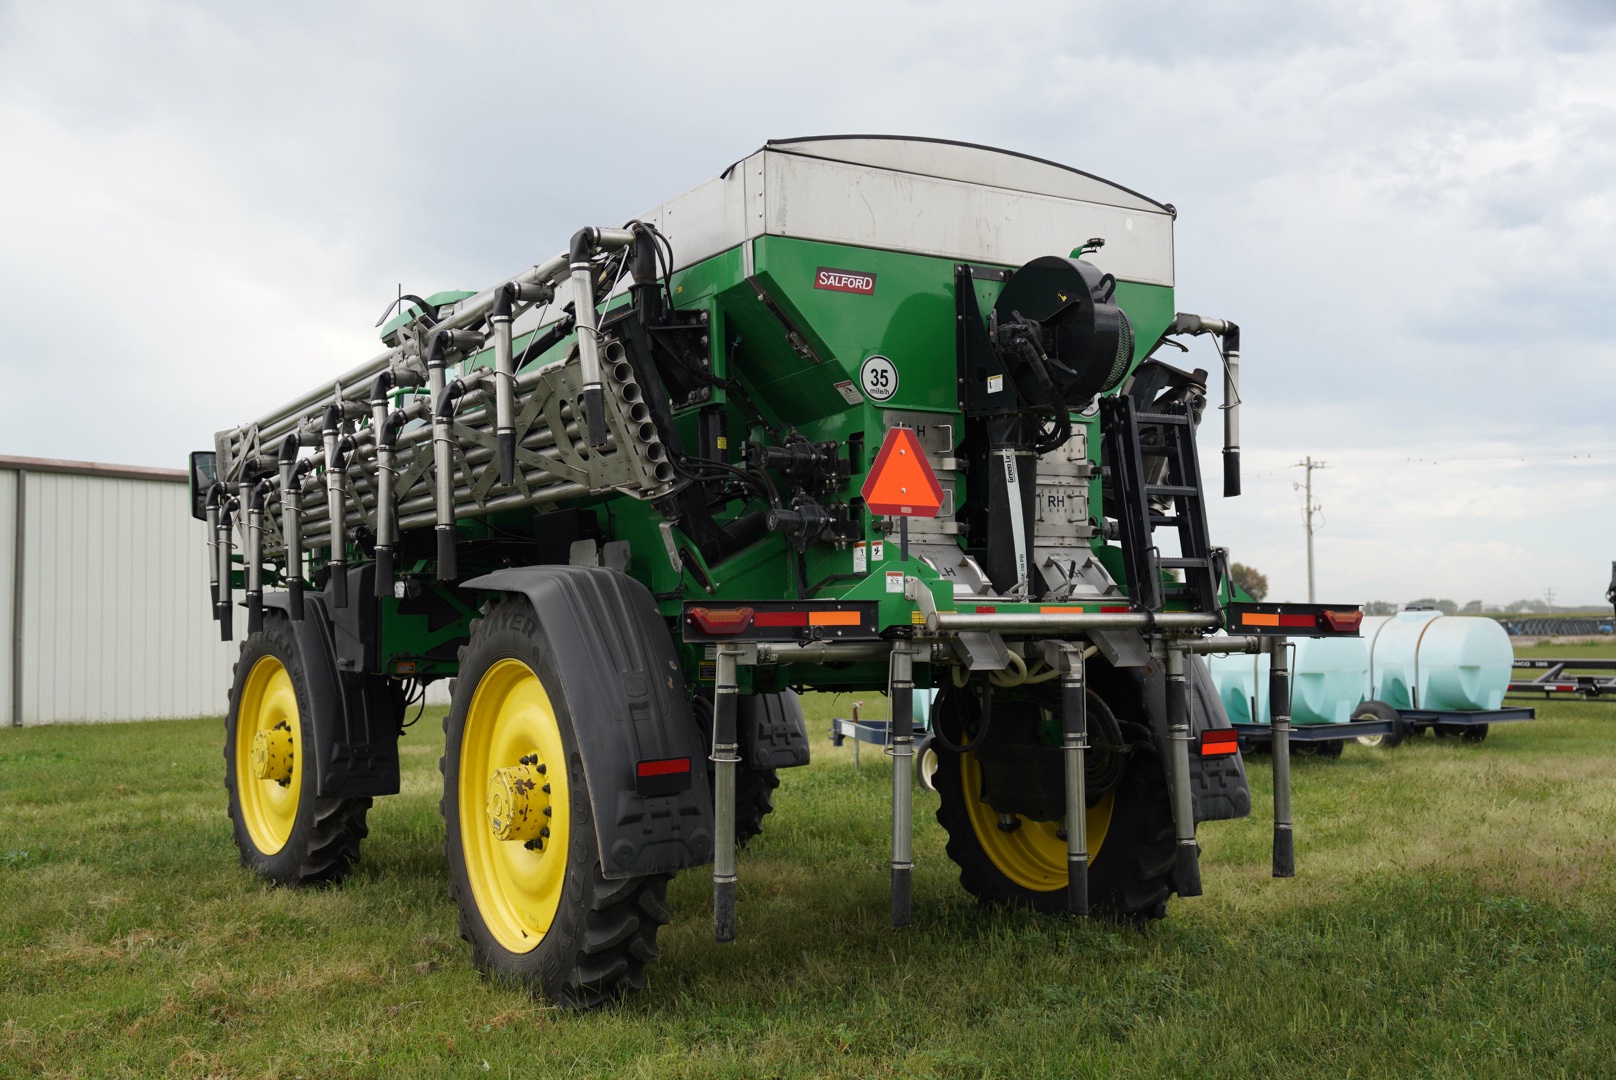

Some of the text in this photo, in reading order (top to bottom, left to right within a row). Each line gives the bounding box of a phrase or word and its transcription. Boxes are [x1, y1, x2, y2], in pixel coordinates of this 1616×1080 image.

[819, 271, 873, 290] SALFORD
[870, 368, 889, 388] 35
[869, 387, 890, 395] mile/h
[1048, 495, 1065, 507] RH
